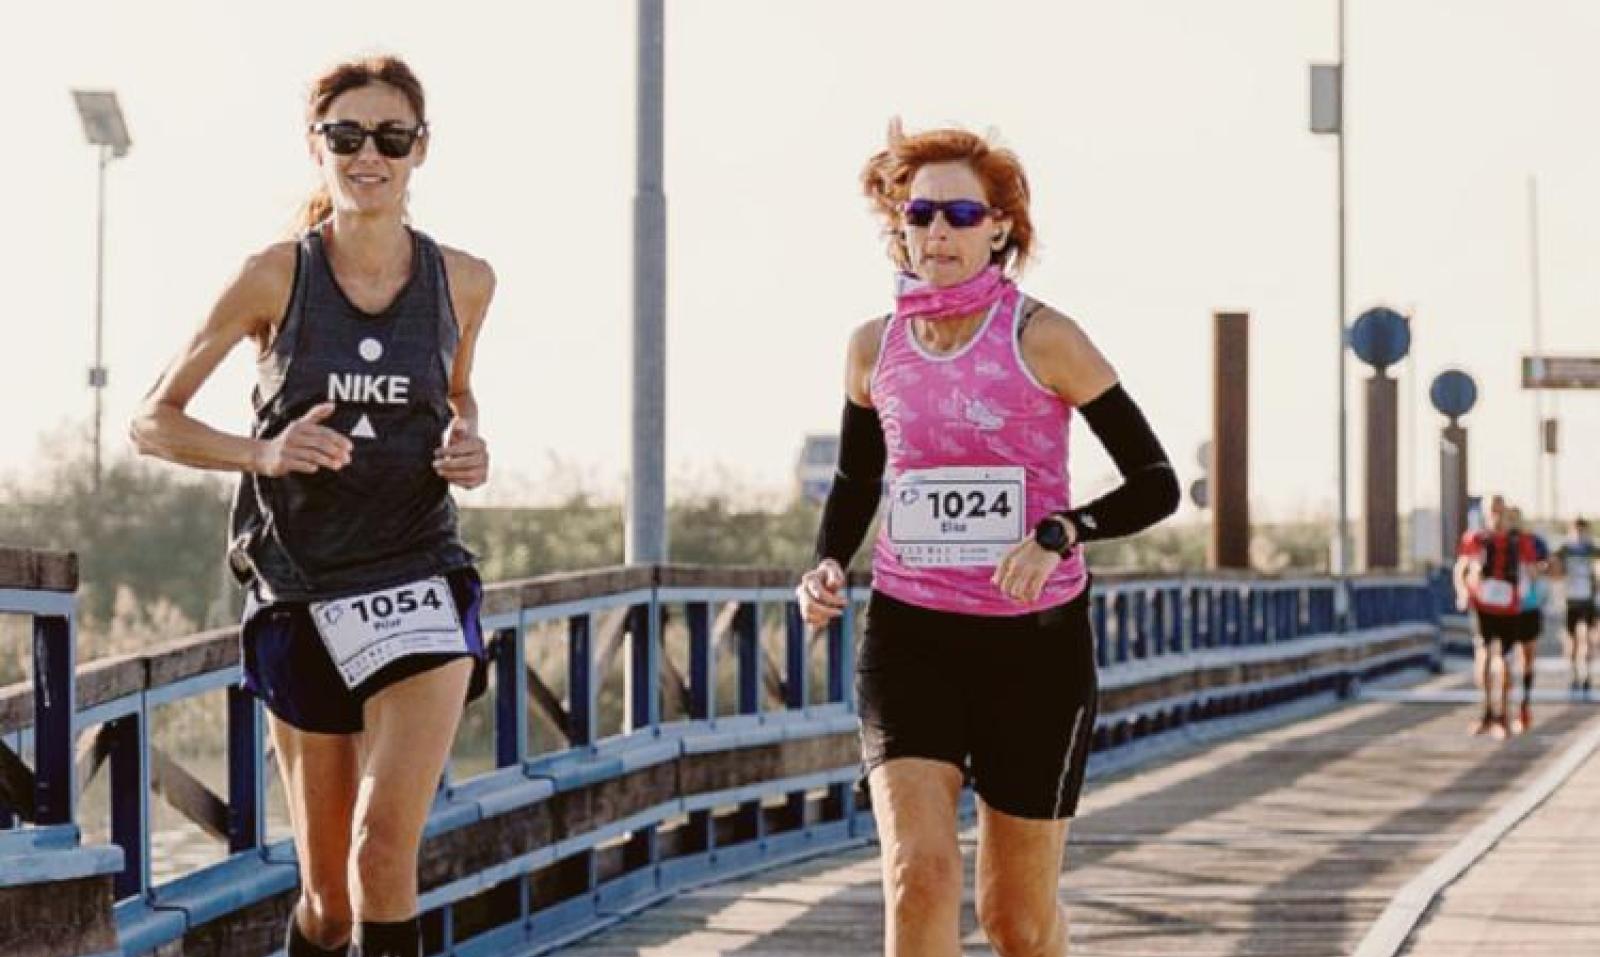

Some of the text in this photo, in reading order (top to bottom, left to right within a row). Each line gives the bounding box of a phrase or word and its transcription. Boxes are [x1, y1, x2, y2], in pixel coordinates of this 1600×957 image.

[327, 372, 411, 404] NIKE
[927, 490, 1012, 519] 1024
[351, 588, 442, 623] 1054
